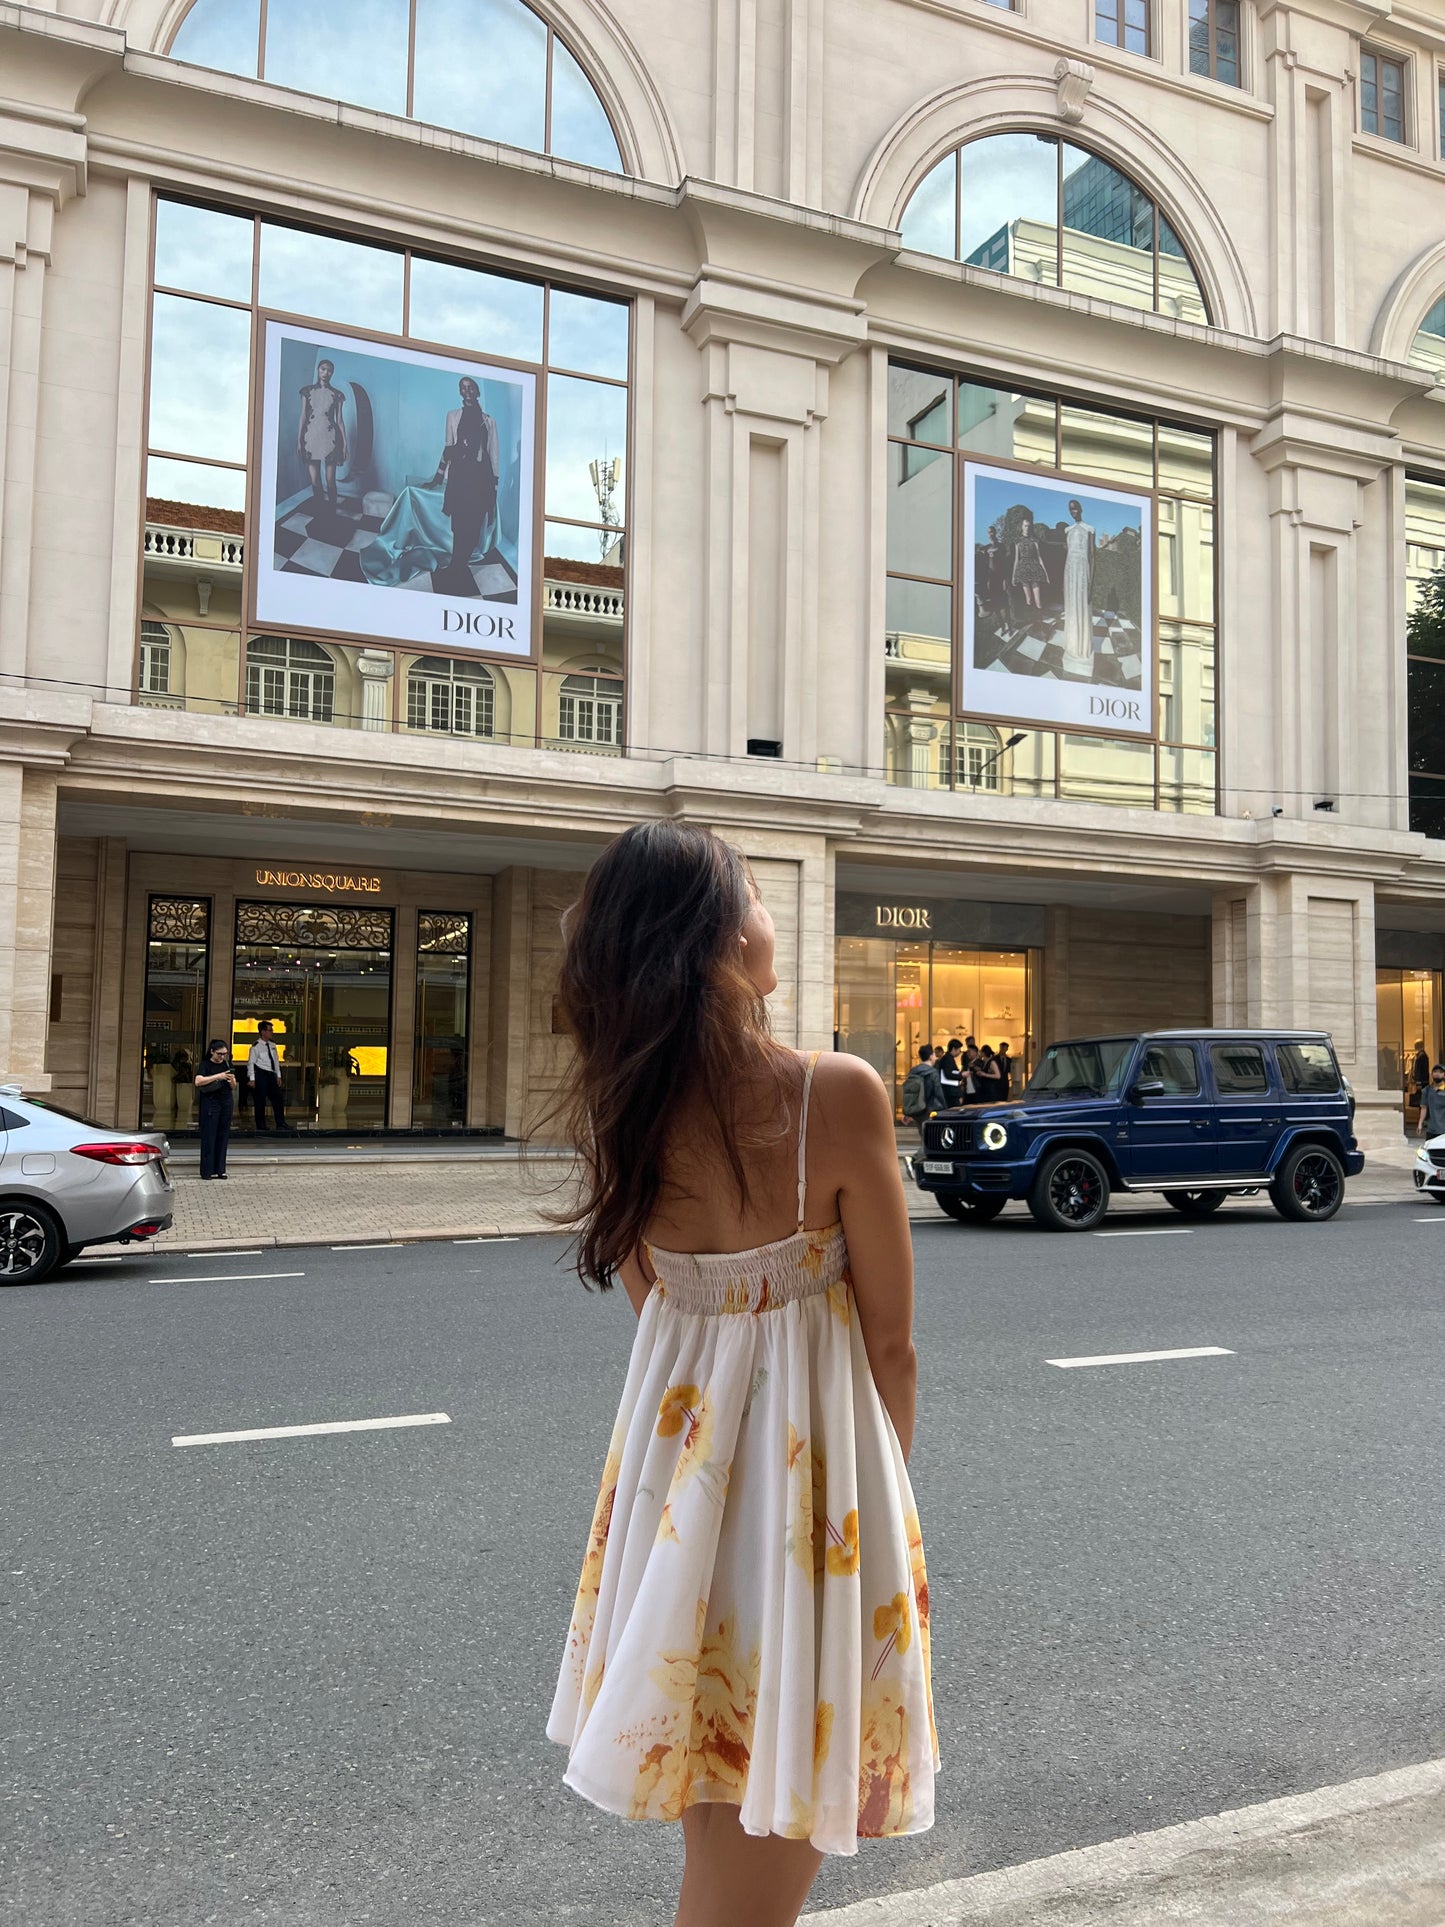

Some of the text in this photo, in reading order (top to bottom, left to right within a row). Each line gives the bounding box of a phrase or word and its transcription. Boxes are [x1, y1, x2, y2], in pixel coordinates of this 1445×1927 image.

[442, 609, 517, 640] DIOR
[1090, 696, 1141, 721] DIOR
[256, 870, 381, 892] UNIONSQUARE
[876, 906, 931, 929] DIOR
